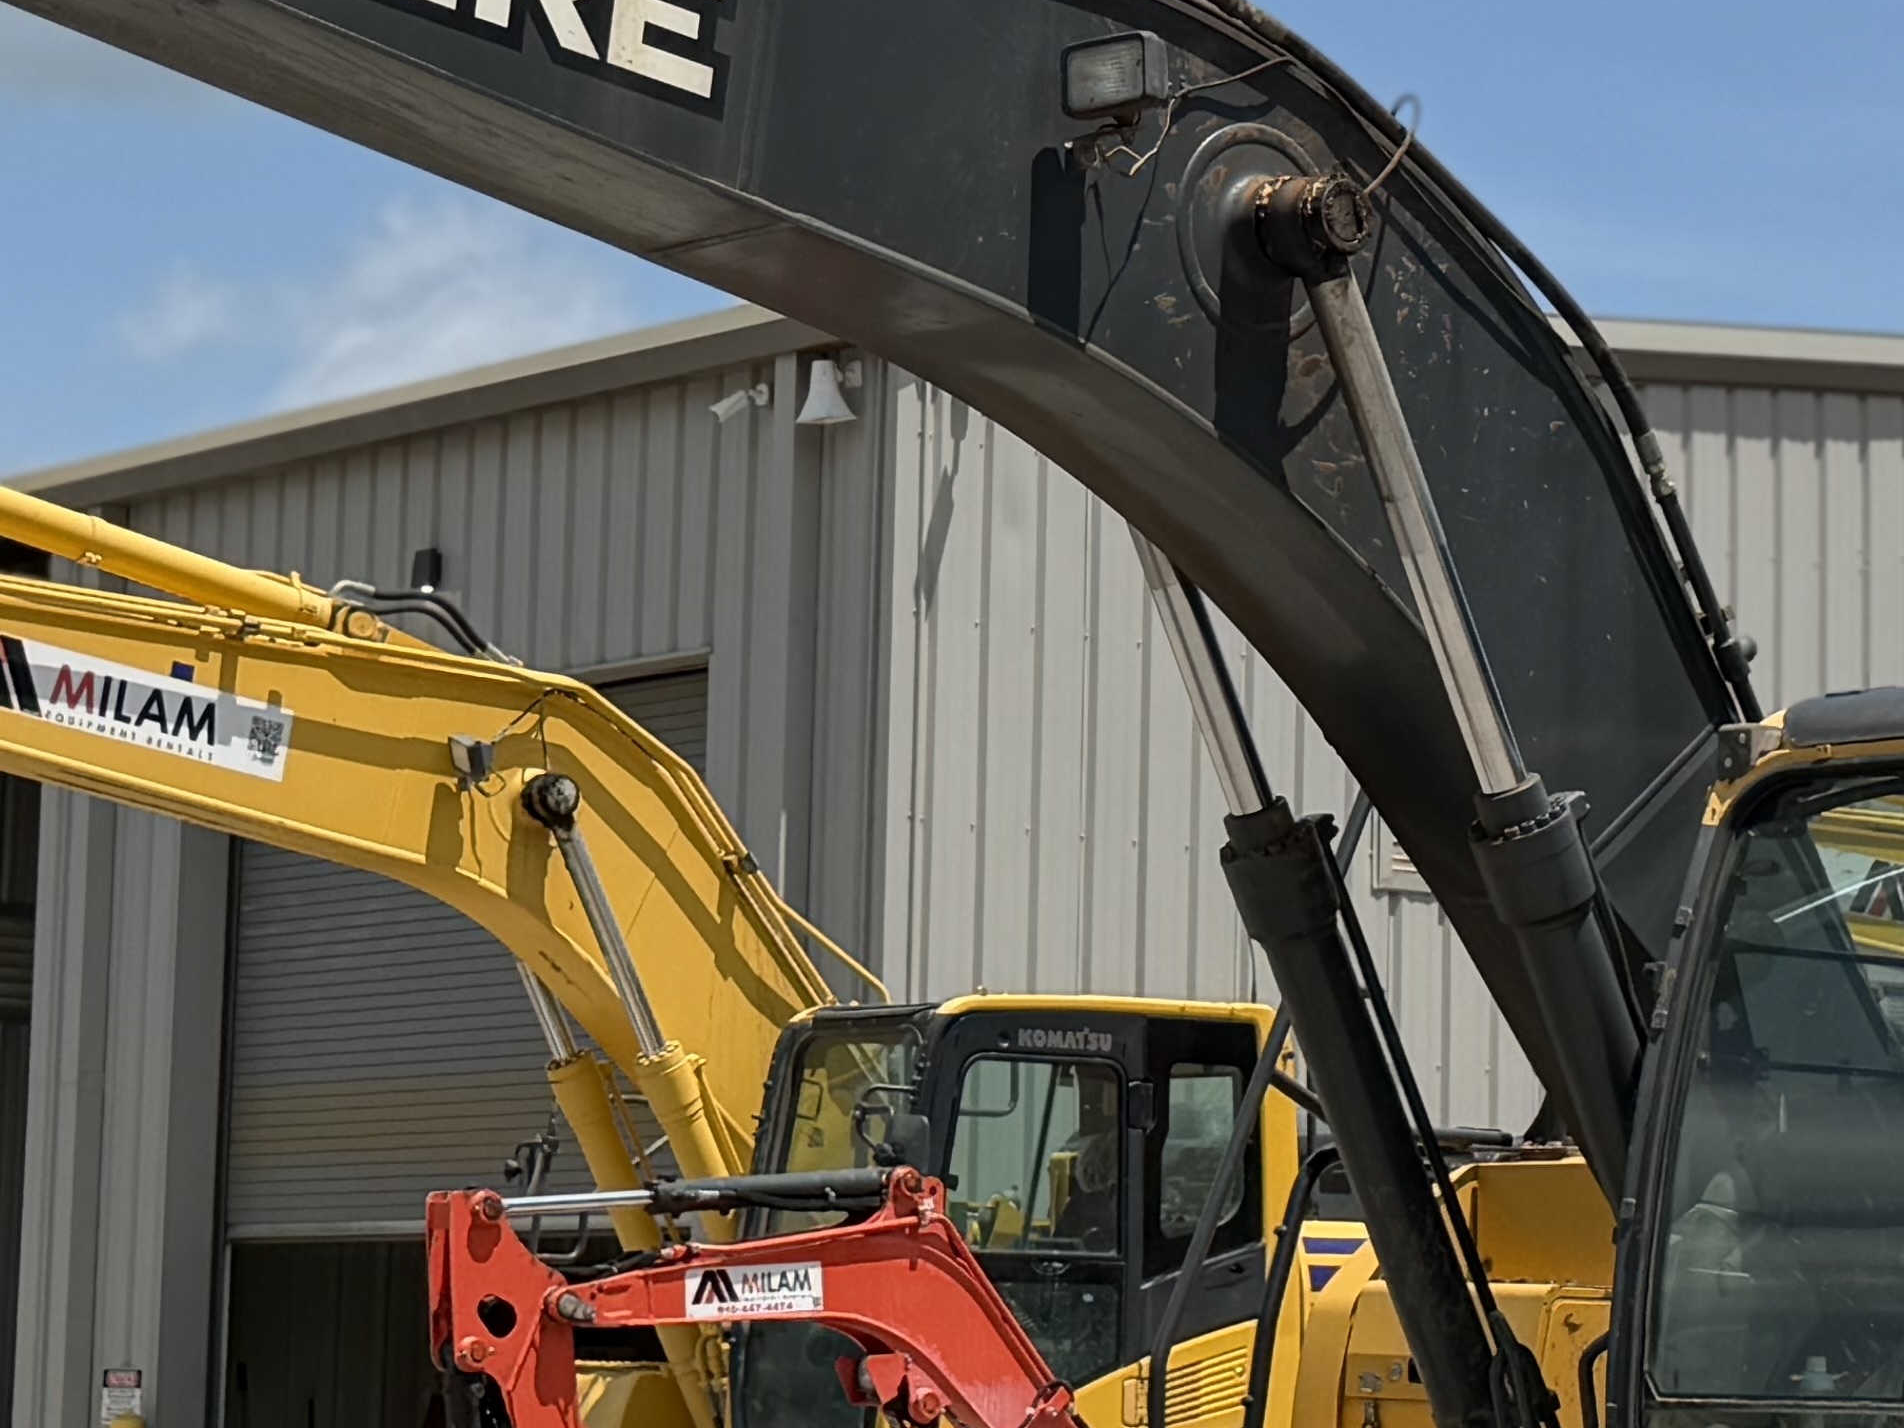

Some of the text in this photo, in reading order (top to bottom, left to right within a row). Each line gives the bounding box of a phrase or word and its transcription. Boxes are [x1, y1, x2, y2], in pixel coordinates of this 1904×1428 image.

[49, 663, 217, 747] MILAM
[44, 709, 215, 763] EQUIPMENT RENTALS
[1017, 1027, 1113, 1052] KOMATSU
[741, 1268, 813, 1295] MILAM
